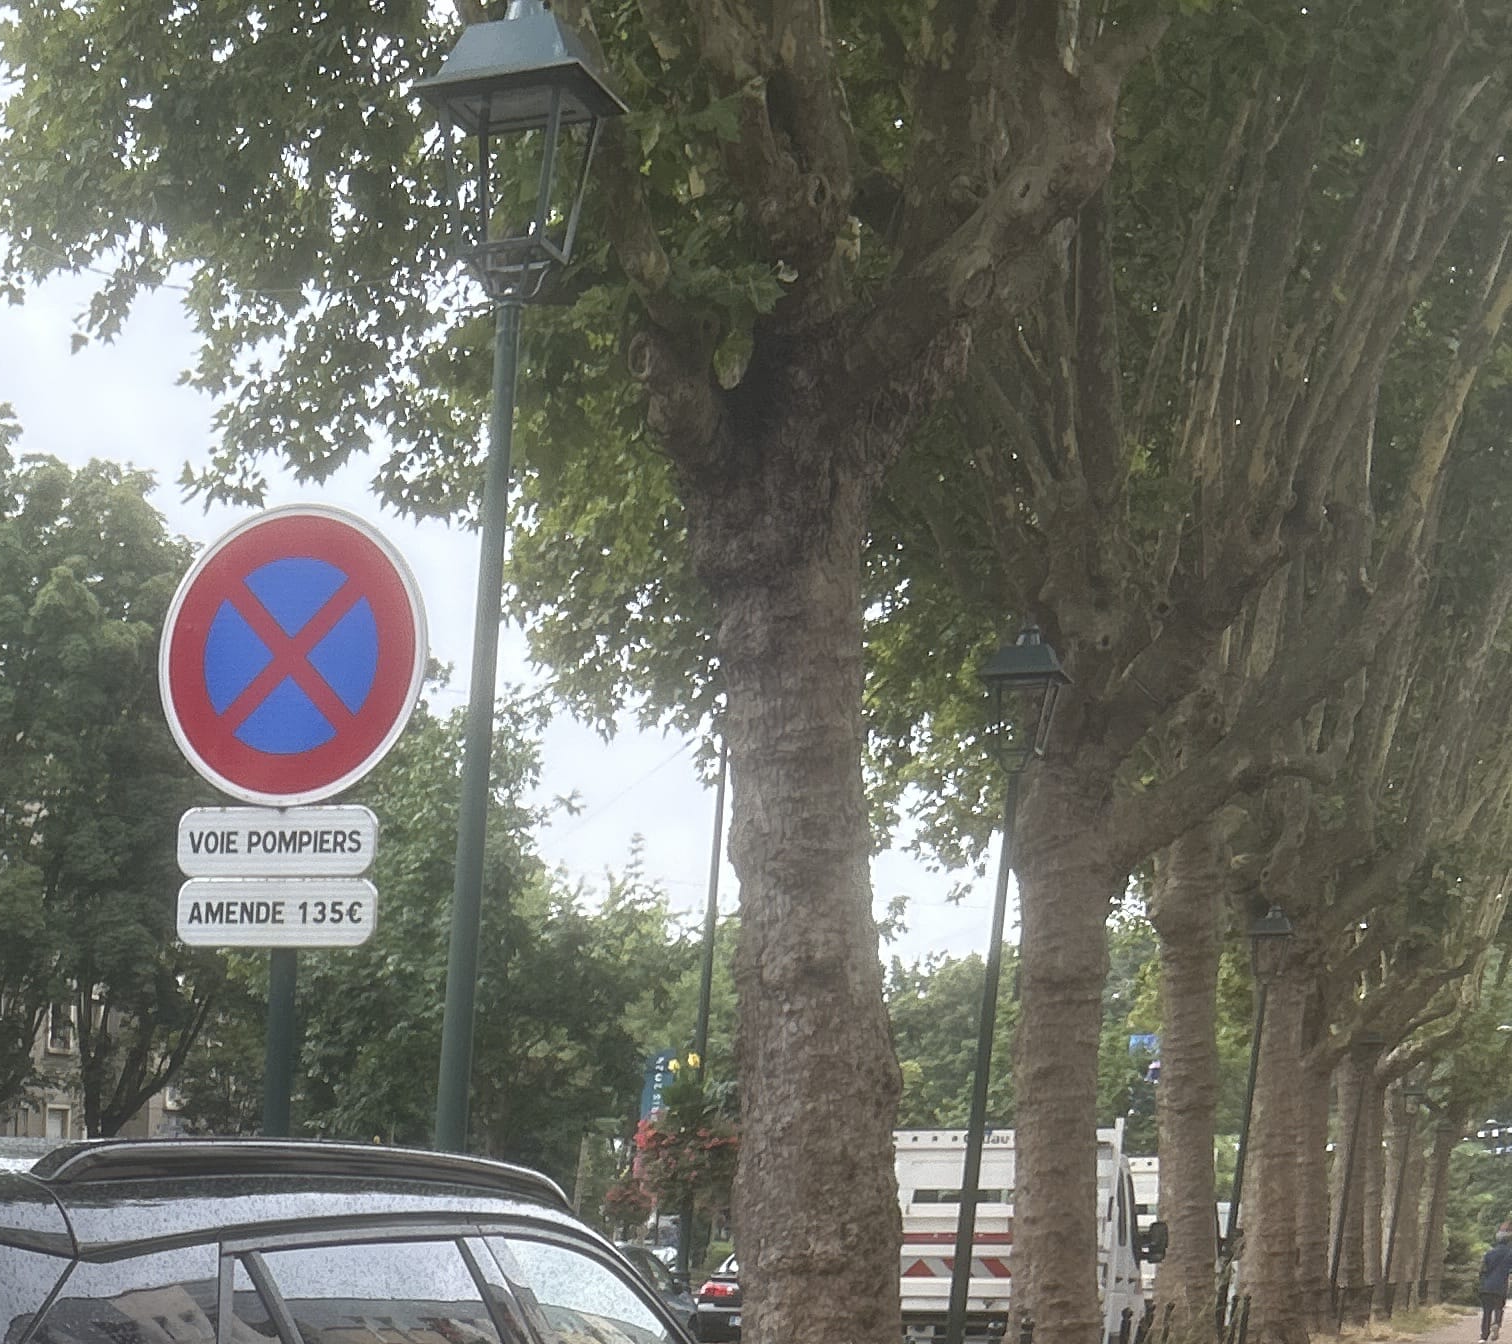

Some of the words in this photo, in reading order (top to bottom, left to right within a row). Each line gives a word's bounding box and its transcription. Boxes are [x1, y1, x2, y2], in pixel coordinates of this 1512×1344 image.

[189, 830, 239, 854] VOIE
[247, 830, 362, 854] POMPIERS
[188, 901, 285, 925] AMENDE
[298, 901, 363, 925] 135€
